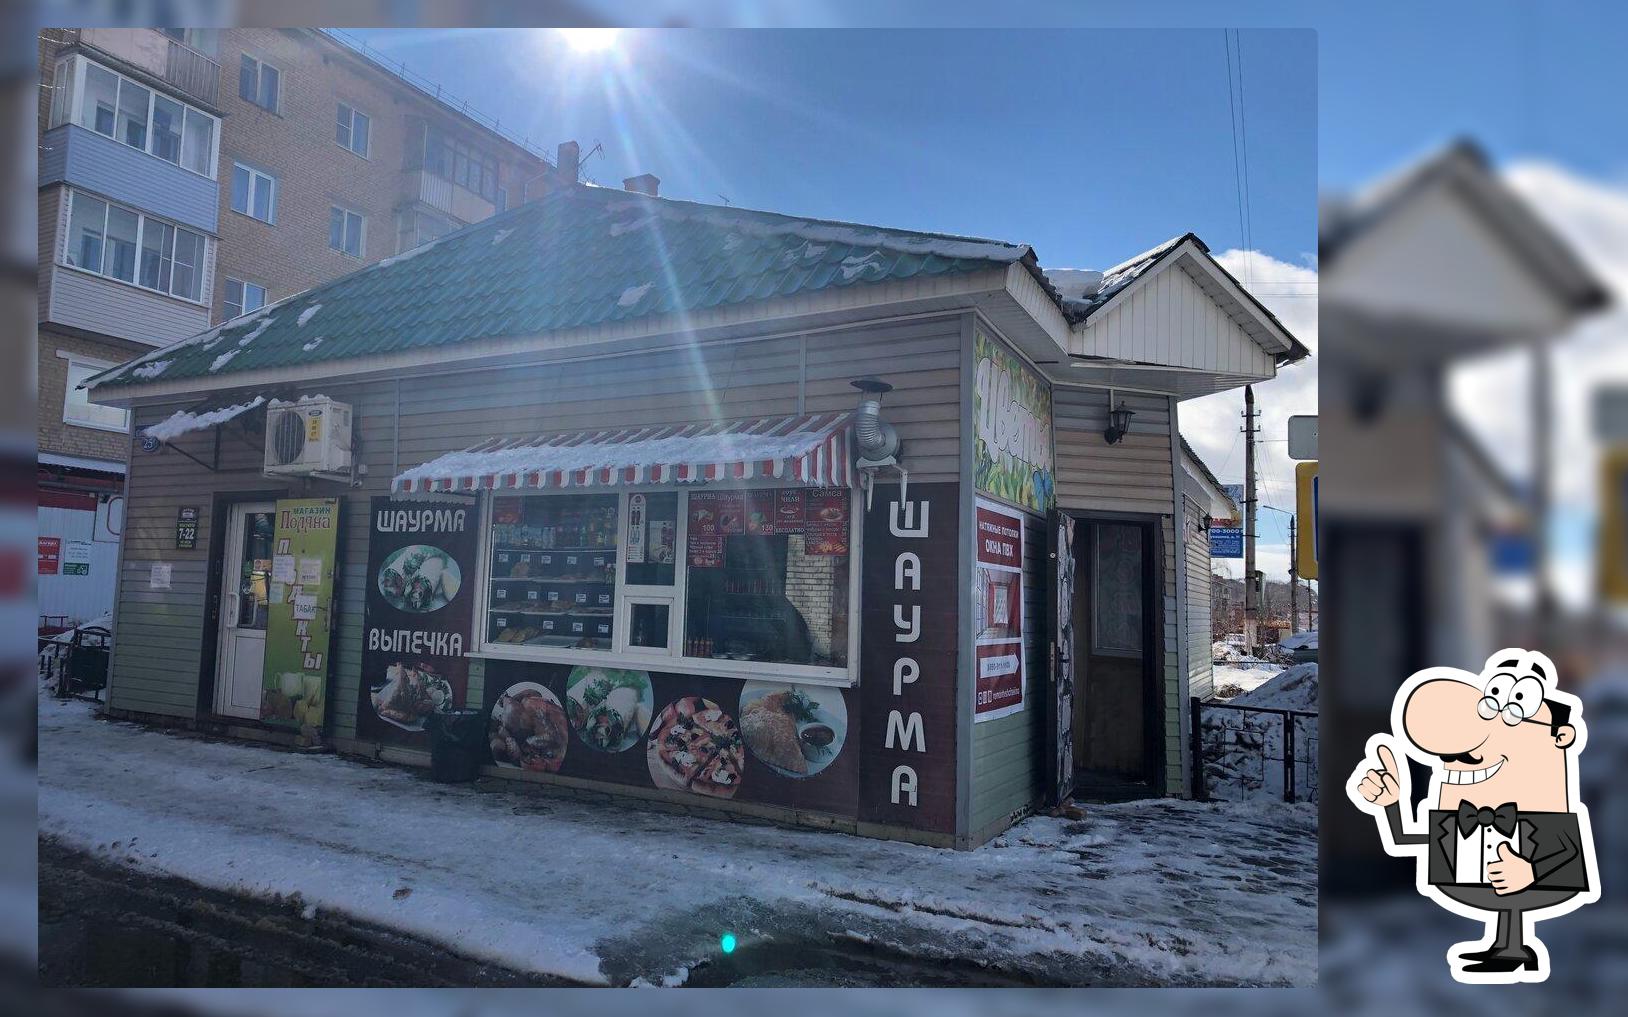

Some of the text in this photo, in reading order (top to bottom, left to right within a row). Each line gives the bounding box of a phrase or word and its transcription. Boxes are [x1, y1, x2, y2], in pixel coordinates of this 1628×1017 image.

[280, 510, 331, 533] Поляна
[376, 509, 466, 533] ШАУРМА
[178, 528, 195, 540] 7-22
[986, 540, 1013, 557] ОКНА ПВХ
[295, 604, 317, 615] ТАБАК
[368, 628, 463, 657] ВЫПЕЧКА
[884, 500, 929, 807] ШАУРМА
